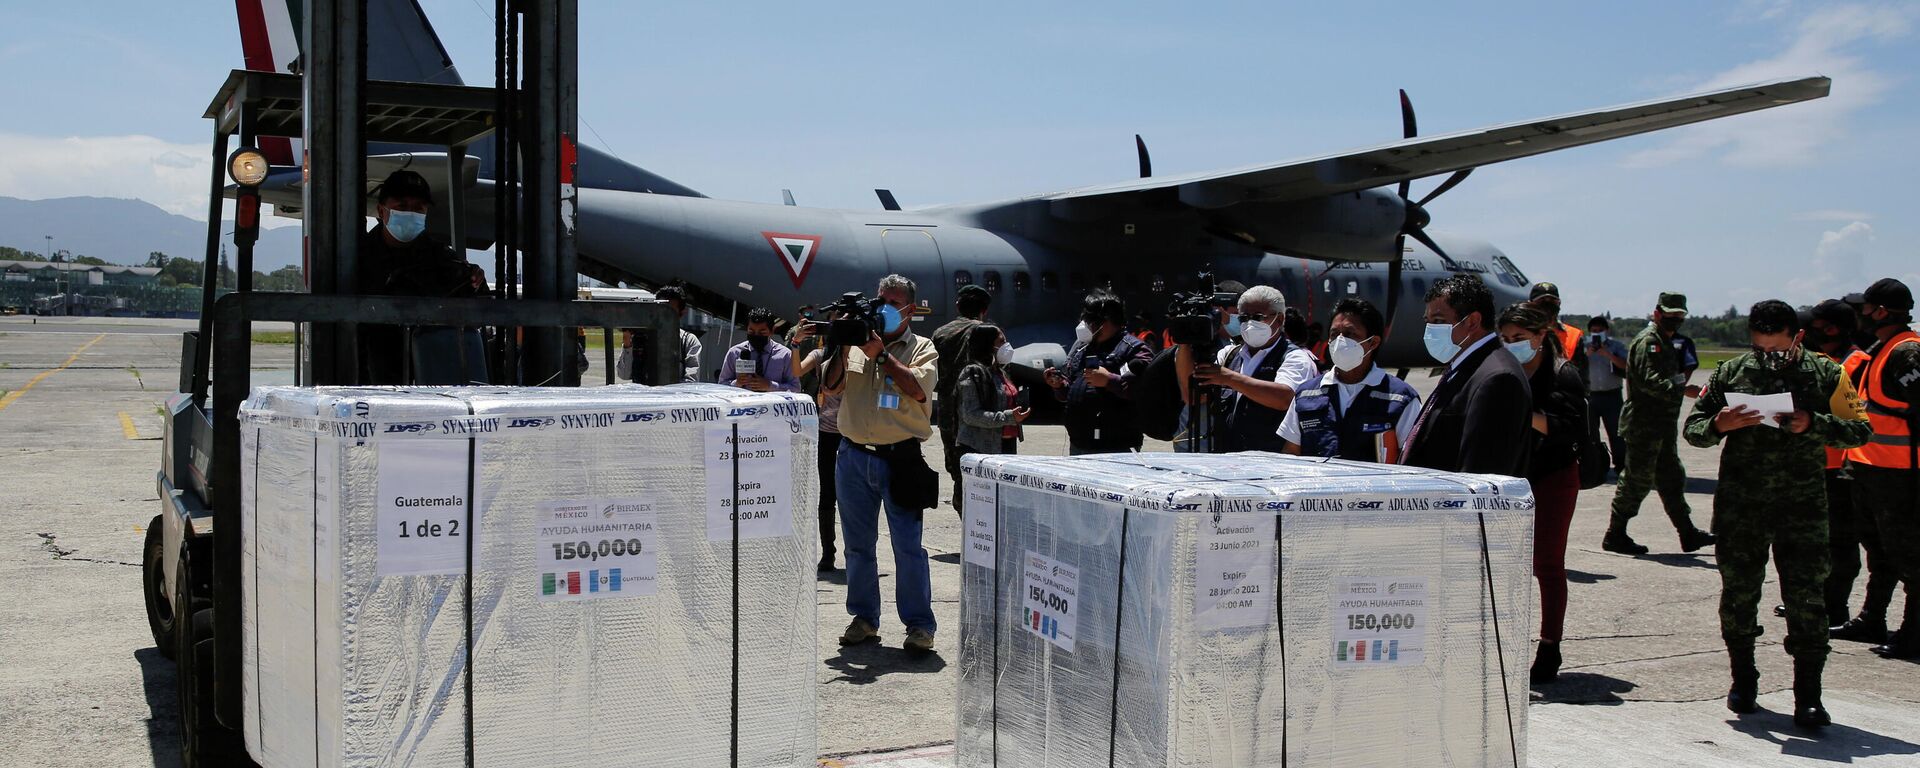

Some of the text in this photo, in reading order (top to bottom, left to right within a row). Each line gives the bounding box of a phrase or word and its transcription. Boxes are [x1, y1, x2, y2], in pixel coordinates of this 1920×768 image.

[621, 413, 651, 422] SAT
[671, 407, 720, 423] ADUANAS
[727, 407, 757, 416] SAT
[442, 417, 500, 434] ADUANAS
[507, 419, 541, 428] SAT
[561, 412, 615, 429] ADUANAS
[384, 424, 421, 433] SAT
[719, 451, 729, 460] 23
[755, 450, 775, 459] 2021
[1003, 473, 1018, 482] SAT
[1020, 474, 1044, 489] ADUANAS
[1051, 482, 1067, 491] SAT
[1070, 484, 1098, 499] ADUANAS
[1106, 492, 1124, 501] SAT
[1128, 495, 1159, 510] ADUANAS
[1206, 499, 1252, 513] ADUANAS
[1266, 502, 1294, 510] SAT
[1300, 498, 1343, 512] ADUANAS
[1357, 501, 1384, 509] SAT
[1388, 497, 1429, 511] ADUANAS
[1442, 500, 1467, 508] SAT
[1472, 497, 1510, 511] ADUANAS
[394, 495, 463, 507] Guatemala
[720, 498, 731, 507] 28
[756, 495, 776, 504] 2021
[616, 504, 652, 513] BIRMEX
[729, 510, 769, 521] 0:00 AM
[399, 519, 460, 538] 1 de 2
[541, 522, 653, 537] AYUDA HUMANITARIA
[552, 538, 642, 561] 150,000
[1209, 542, 1219, 550] 23
[1220, 541, 1240, 550] Junio
[1209, 588, 1219, 597] 28
[1242, 585, 1260, 594] 2021
[1239, 600, 1253, 608] AM
[1340, 599, 1368, 608] AYUDA
[1347, 613, 1415, 632] 150,000
